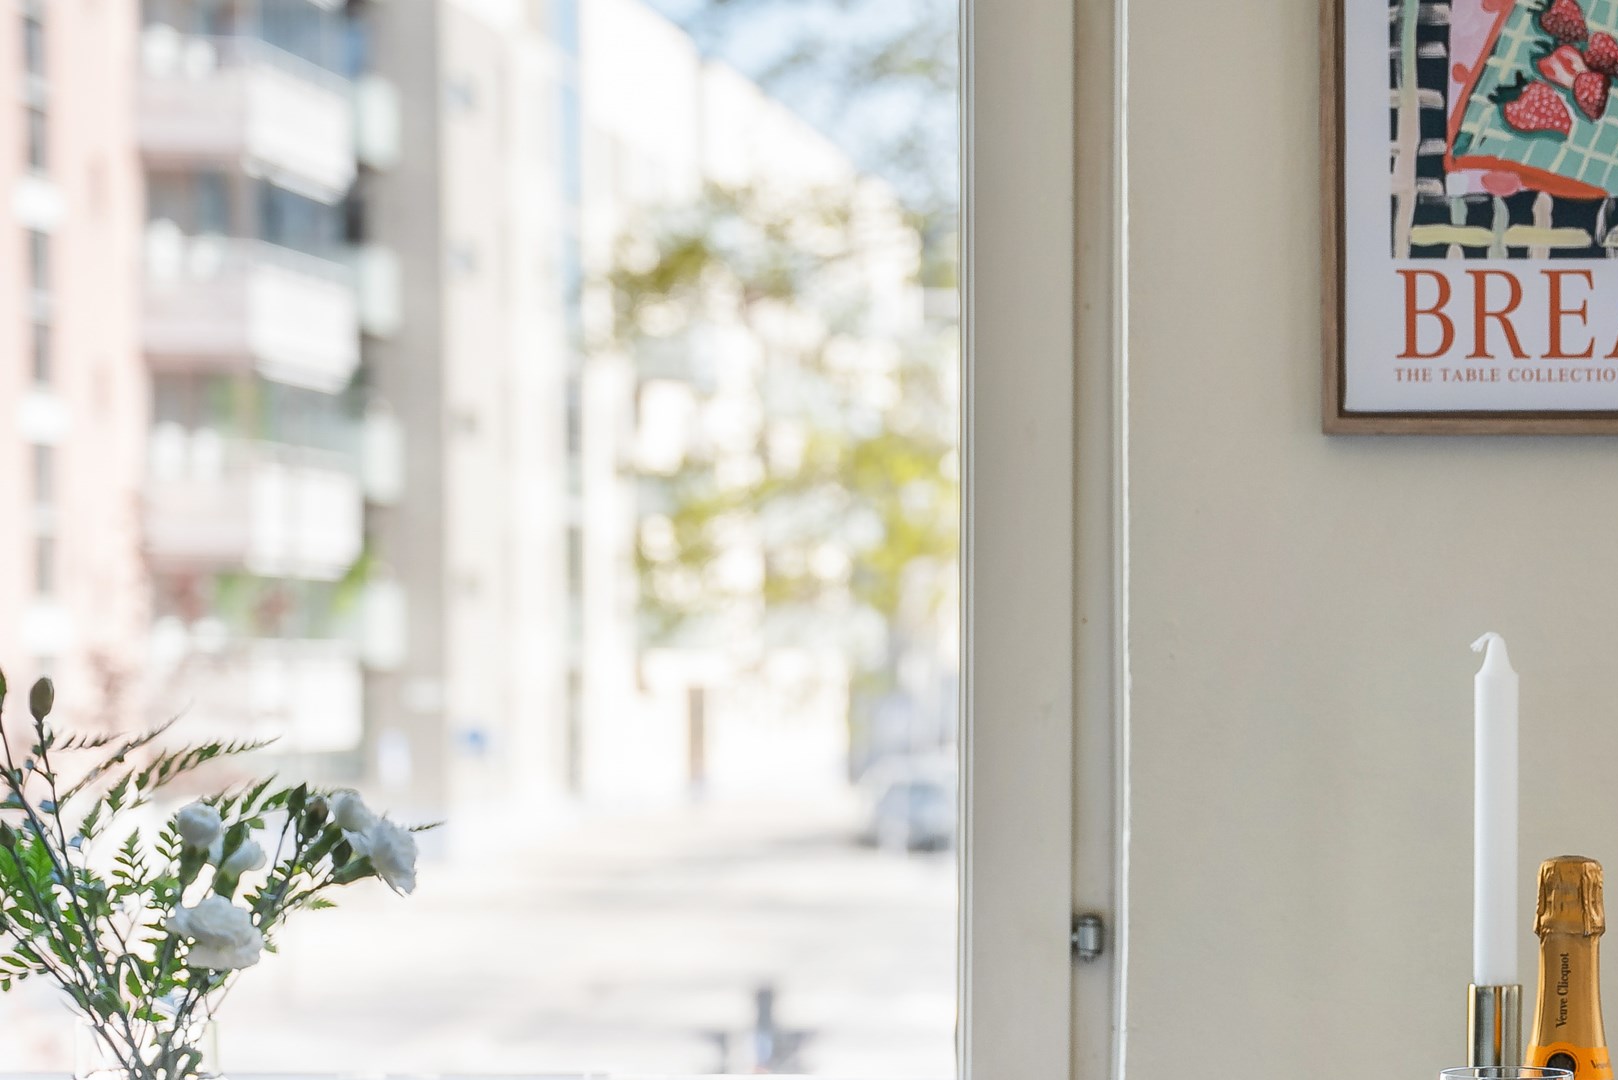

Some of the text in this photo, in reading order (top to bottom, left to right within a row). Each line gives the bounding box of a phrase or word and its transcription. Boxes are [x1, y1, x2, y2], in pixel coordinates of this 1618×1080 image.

[1394, 367, 1433, 383] THE
[1439, 367, 1501, 383] TABLE
[1555, 952, 1571, 1029] Veuve Clicquot
